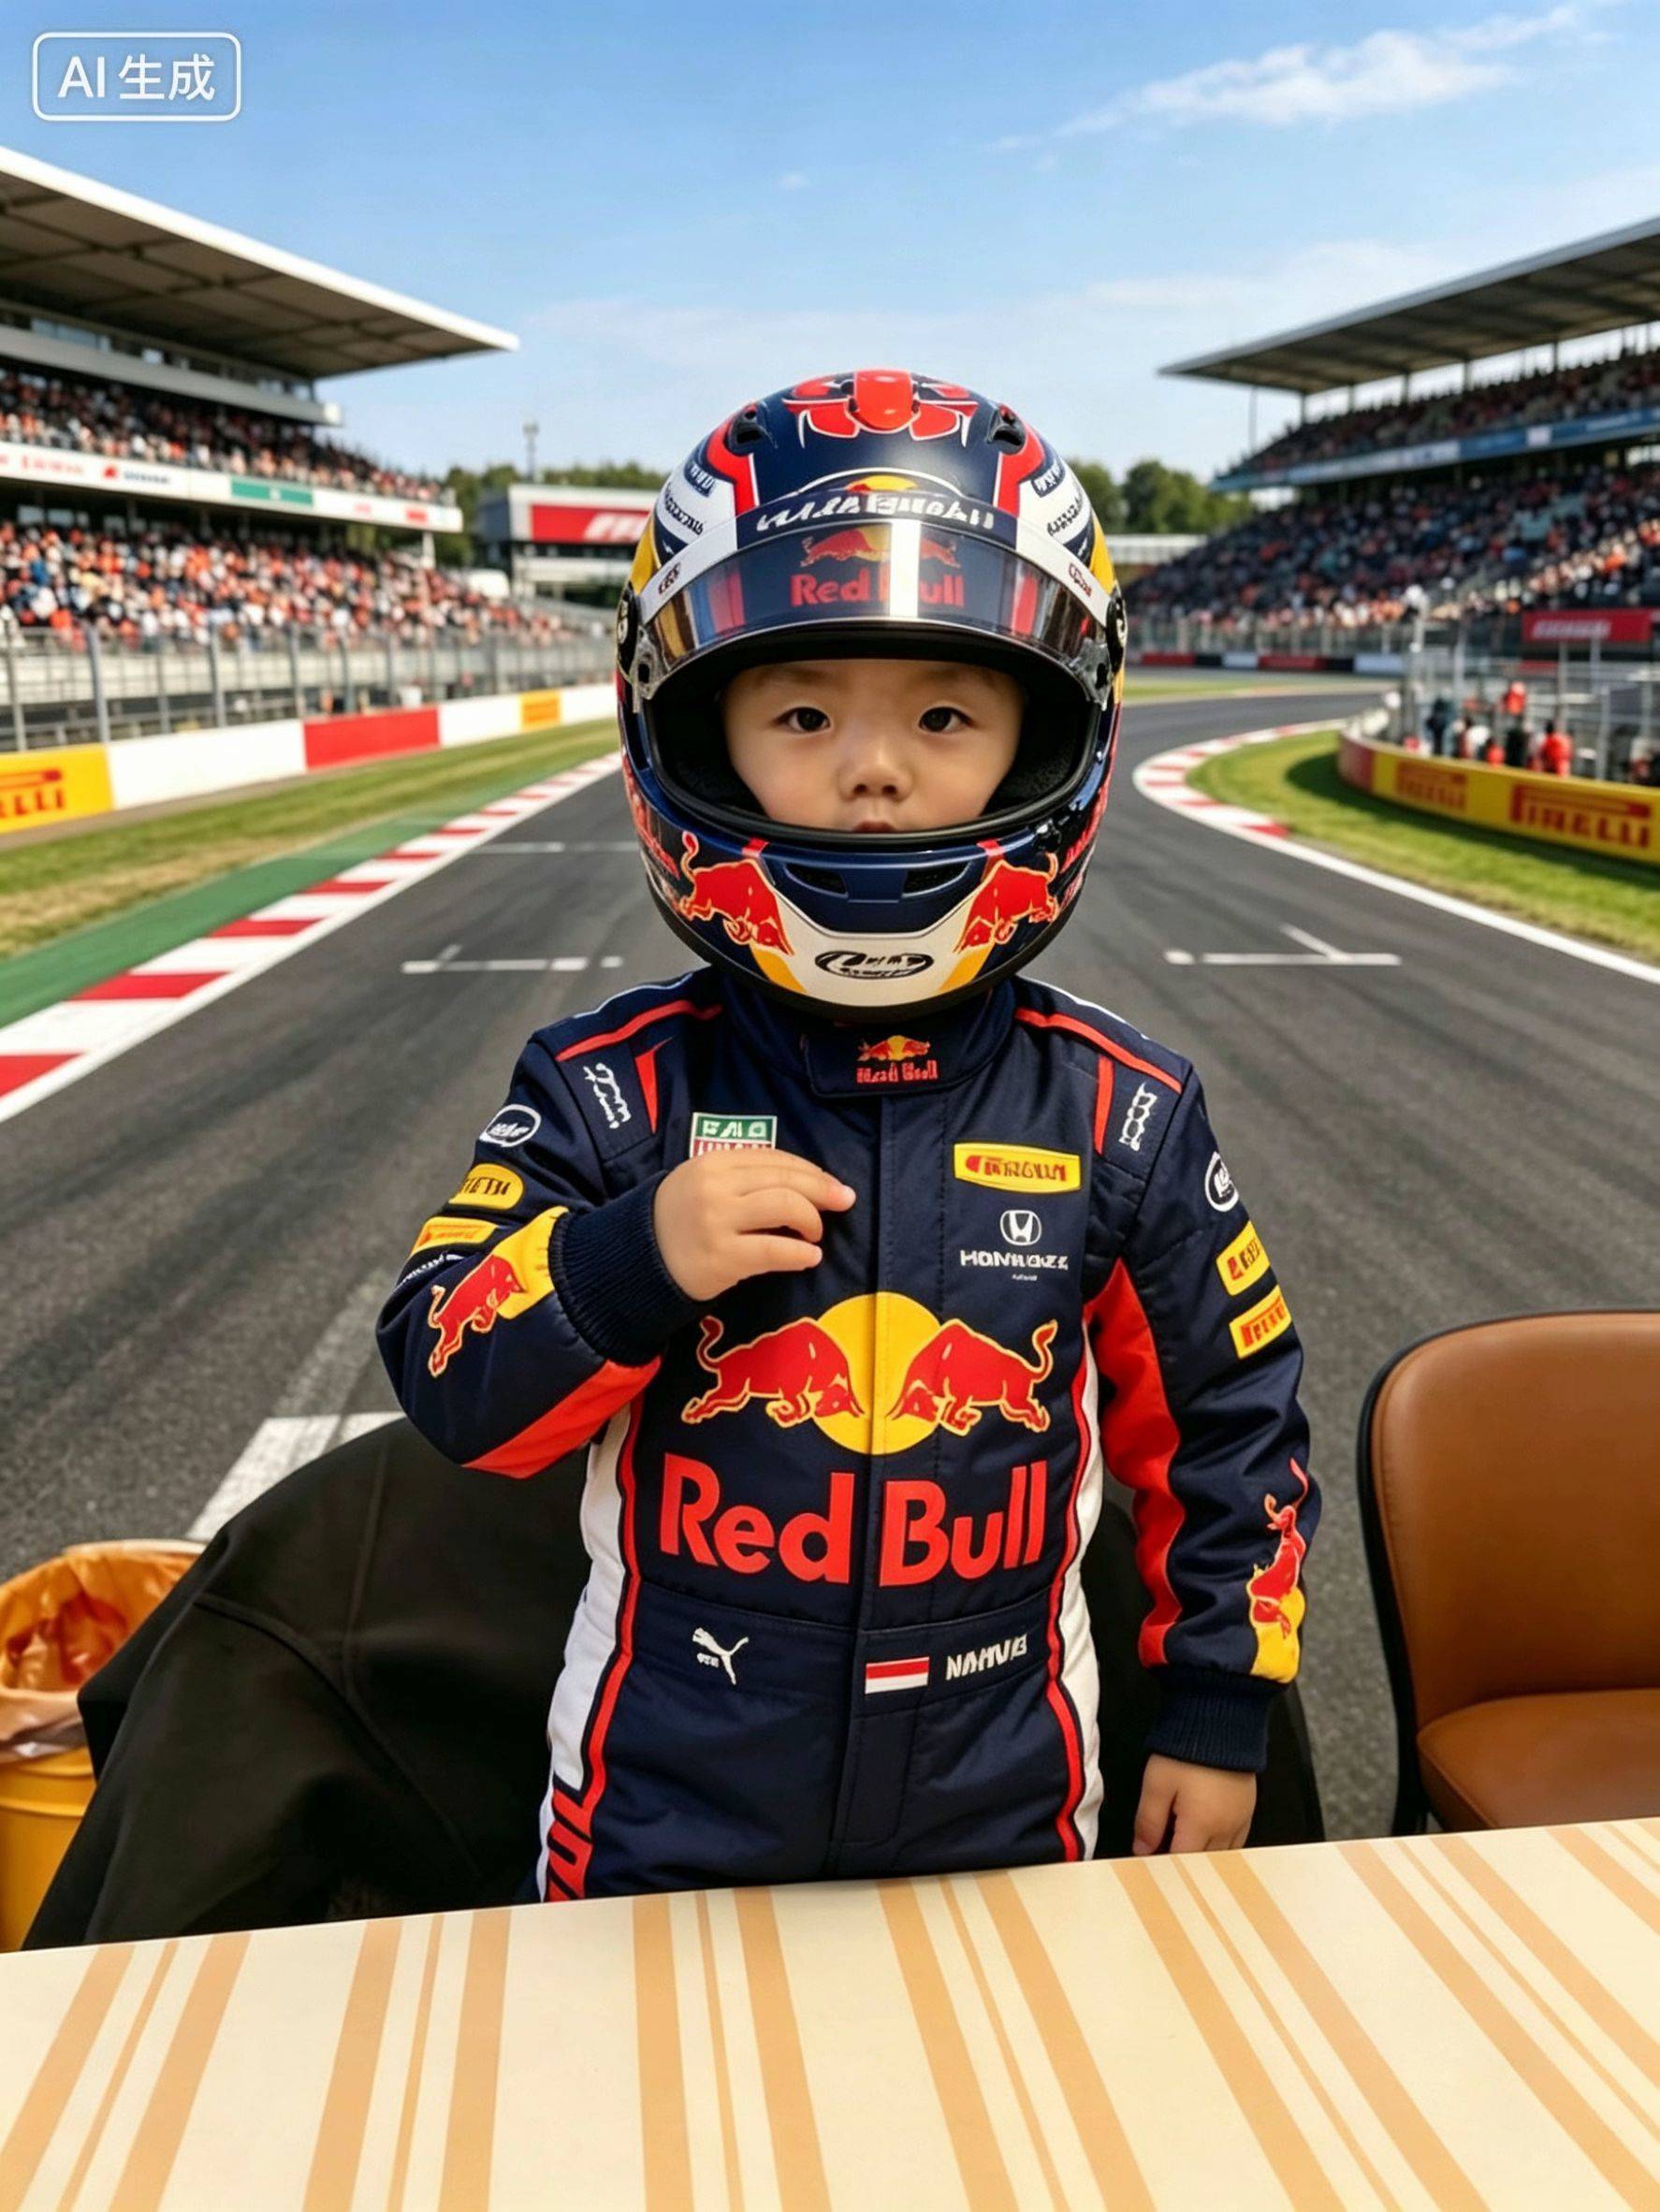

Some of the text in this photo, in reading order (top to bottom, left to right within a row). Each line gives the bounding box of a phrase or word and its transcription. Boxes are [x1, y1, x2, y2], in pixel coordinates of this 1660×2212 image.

[791, 561, 965, 606] Red ull
[1509, 782, 1652, 849] PIRELLI
[661, 1452, 1048, 1587] Red Bull
